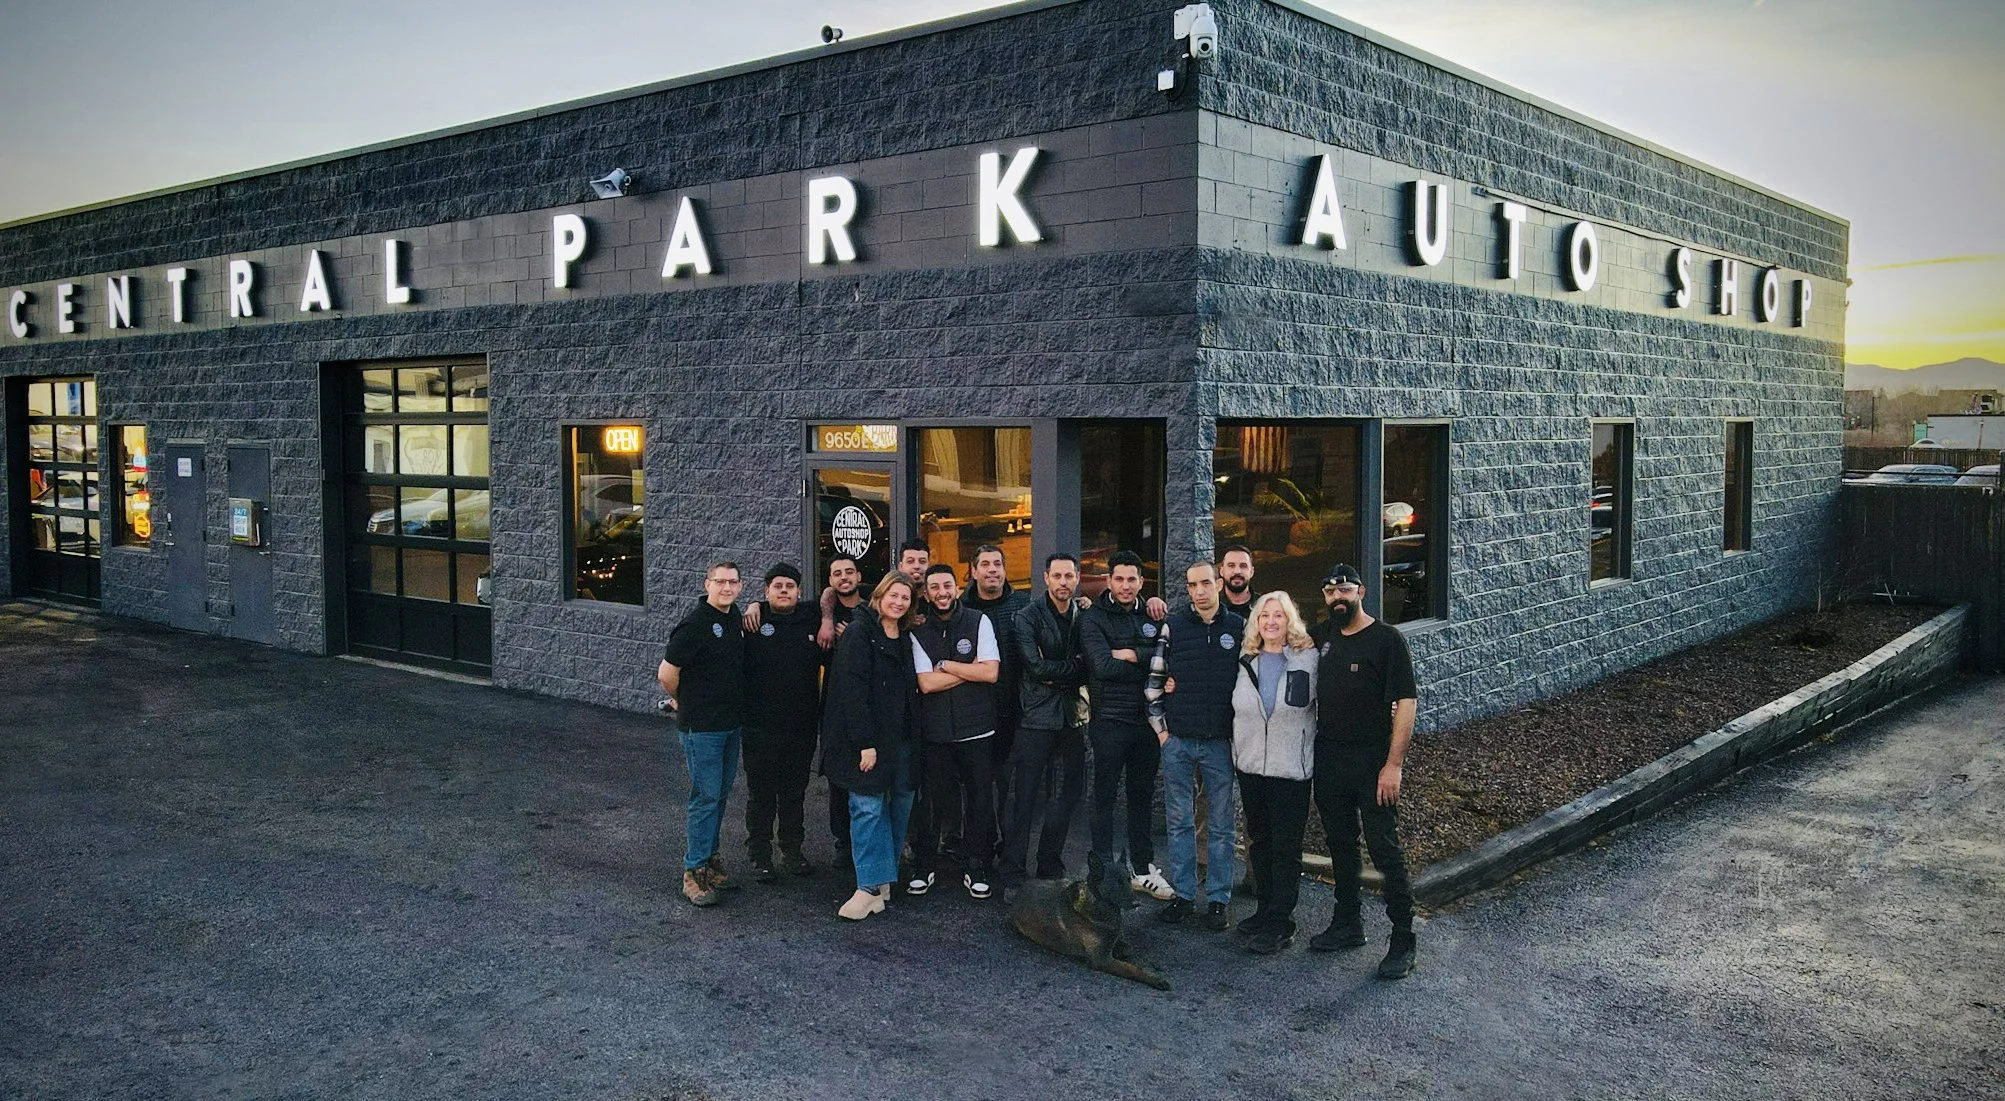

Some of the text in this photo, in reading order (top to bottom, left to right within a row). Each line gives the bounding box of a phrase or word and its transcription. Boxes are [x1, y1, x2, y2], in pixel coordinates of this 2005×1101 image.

[9, 146, 1040, 338] CENTRAL PARK
[1299, 153, 1813, 328] AUTO SHOP
[605, 428, 639, 452] OPEN
[825, 432, 860, 449] 9650
[836, 509, 868, 528] CENTRAL
[834, 527, 870, 540] AUTOSHOP
[841, 538, 863, 557] PARK
